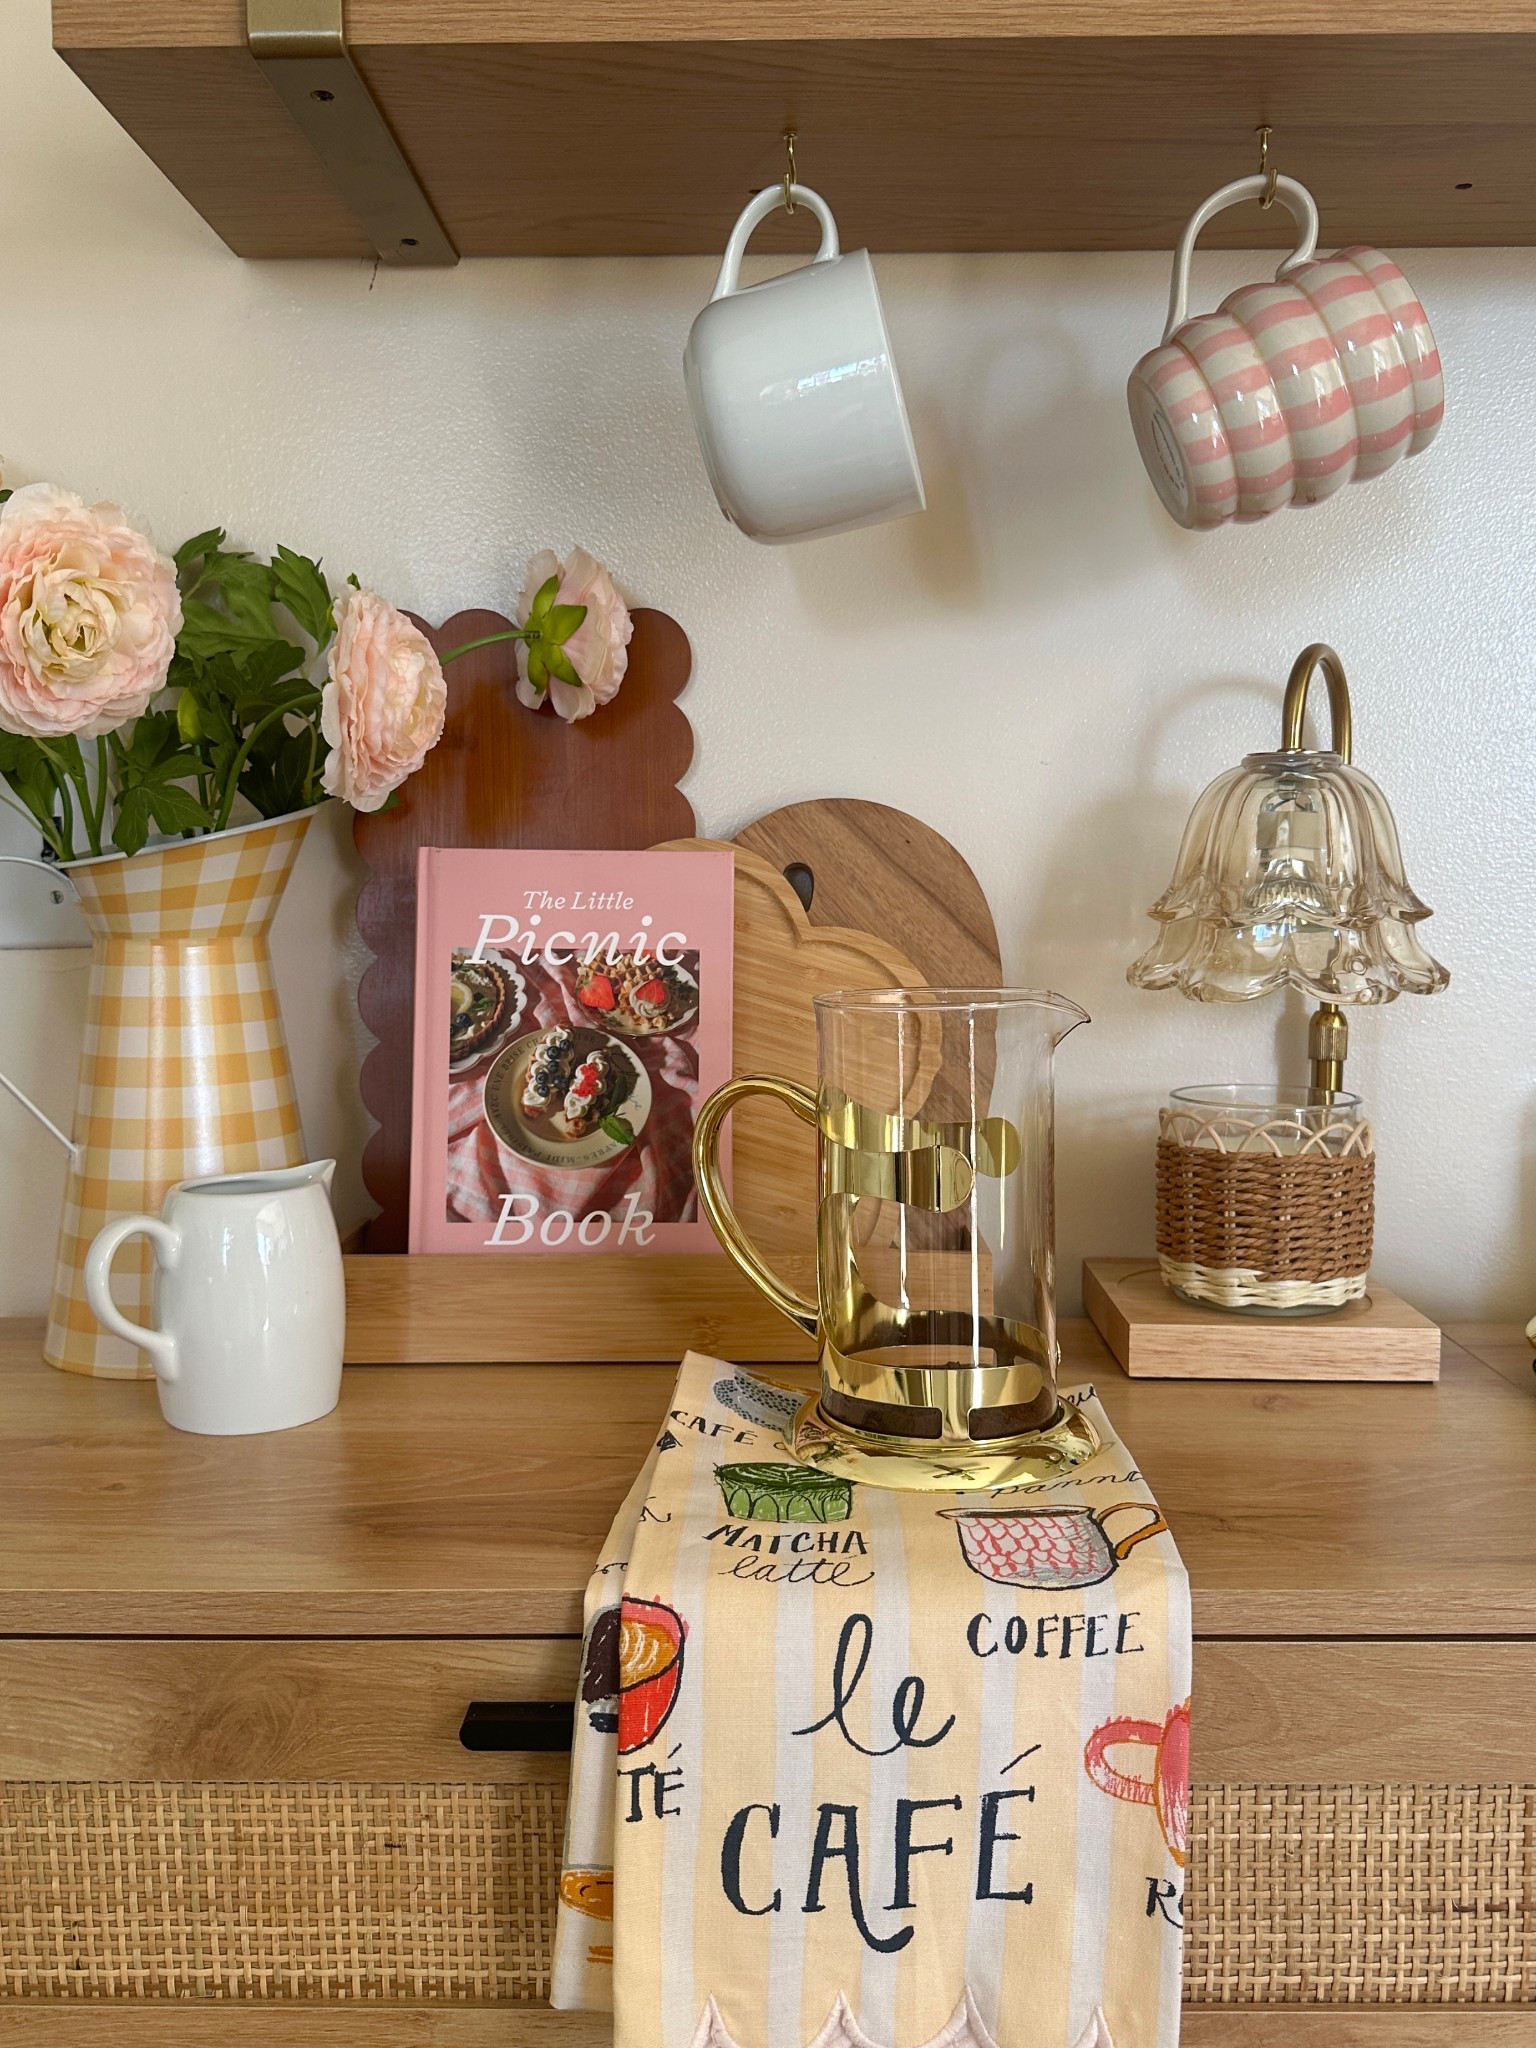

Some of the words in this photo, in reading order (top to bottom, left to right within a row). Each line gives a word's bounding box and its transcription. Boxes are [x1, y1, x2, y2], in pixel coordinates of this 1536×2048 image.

[523, 890, 567, 910] The
[569, 890, 634, 910] Little
[464, 914, 688, 967] Picnic
[483, 1191, 657, 1247] Book
[669, 1410, 759, 1446] CAFÉ
[702, 1524, 871, 1555] MATCHA
[967, 1611, 1145, 1659] COFFEE
[791, 1613, 956, 1757] le
[720, 1744, 1042, 1954] CAFÉ
